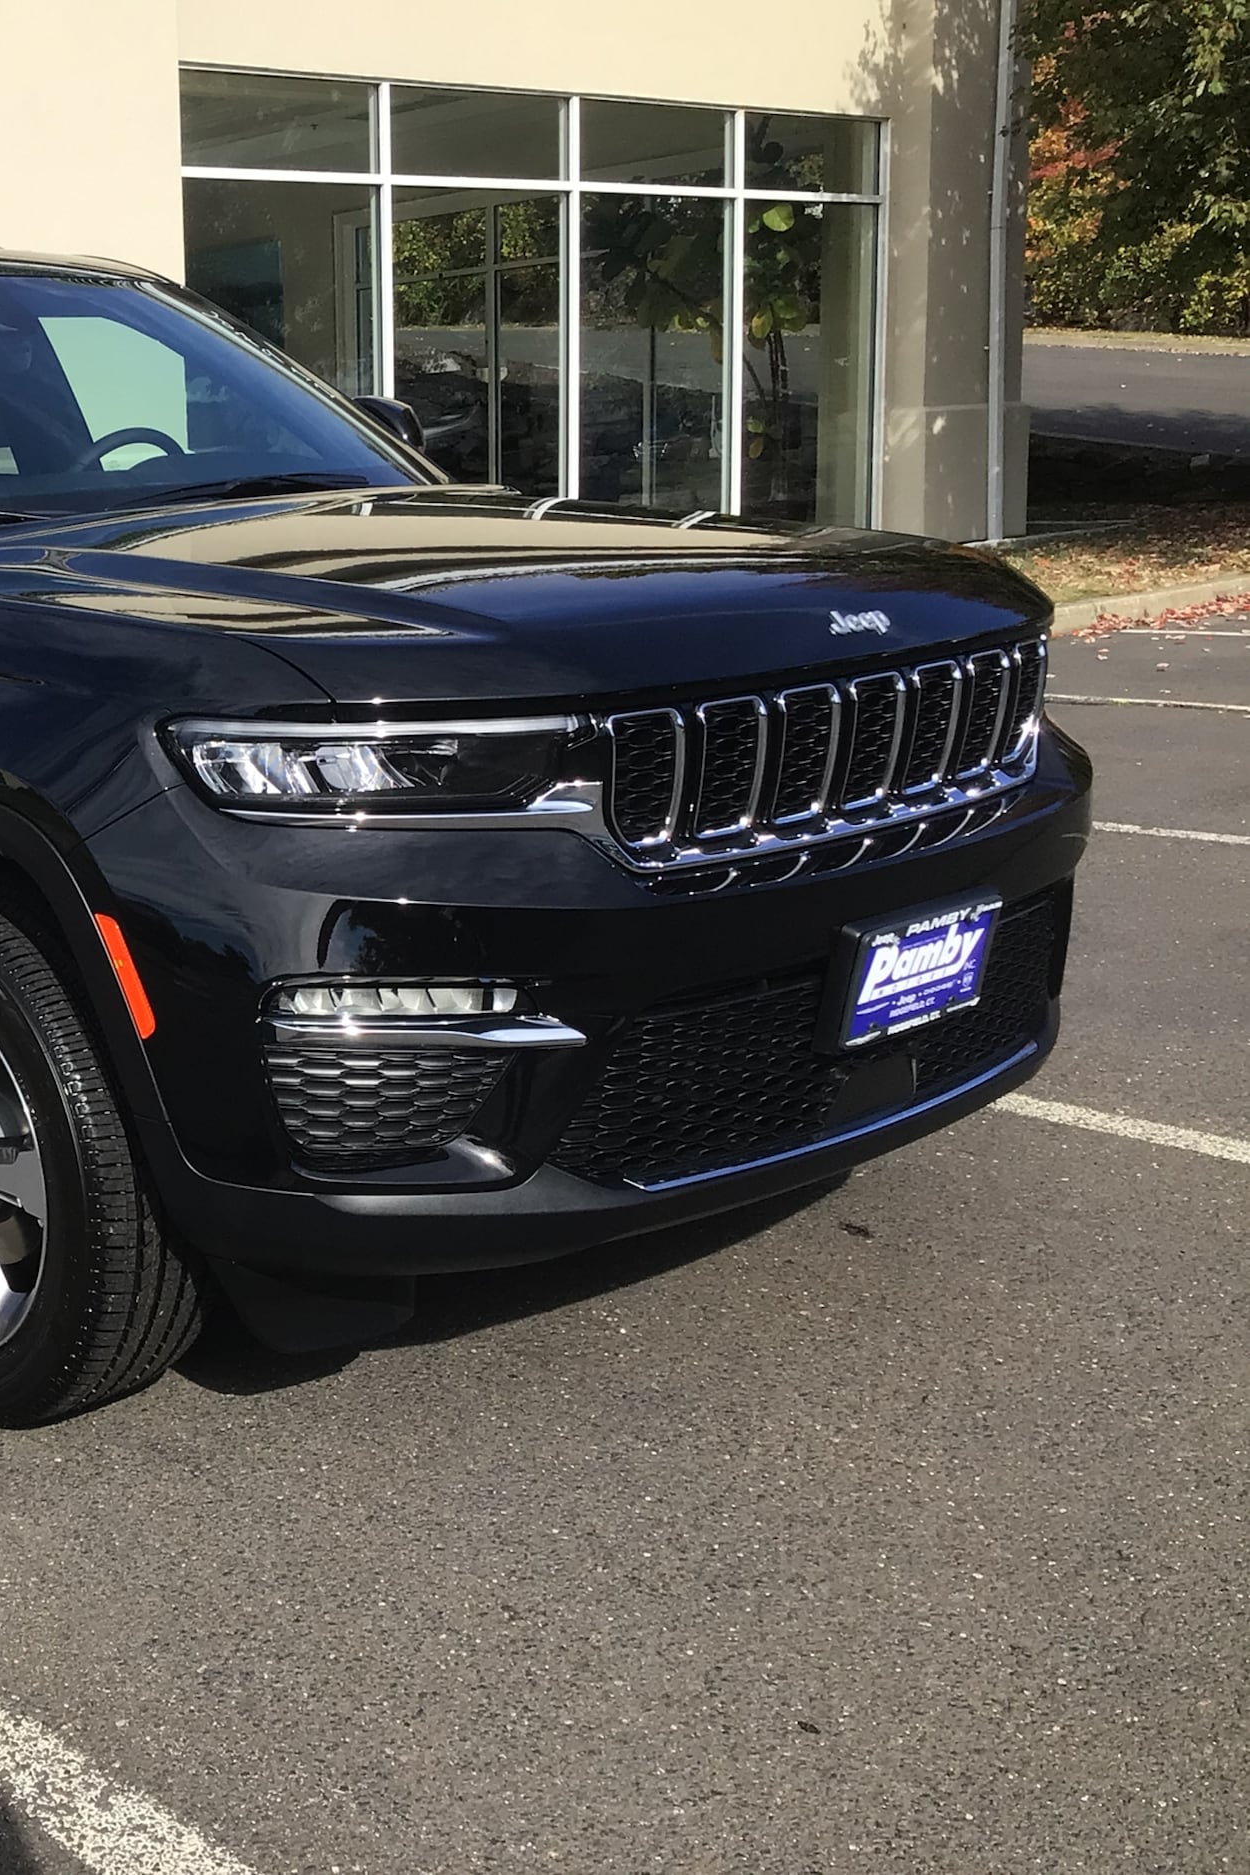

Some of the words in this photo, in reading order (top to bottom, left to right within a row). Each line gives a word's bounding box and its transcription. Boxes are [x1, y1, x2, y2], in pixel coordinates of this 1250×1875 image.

[829, 609, 891, 636] Jeep
[906, 907, 971, 937] PAMBY
[857, 923, 985, 1005] Pamby
